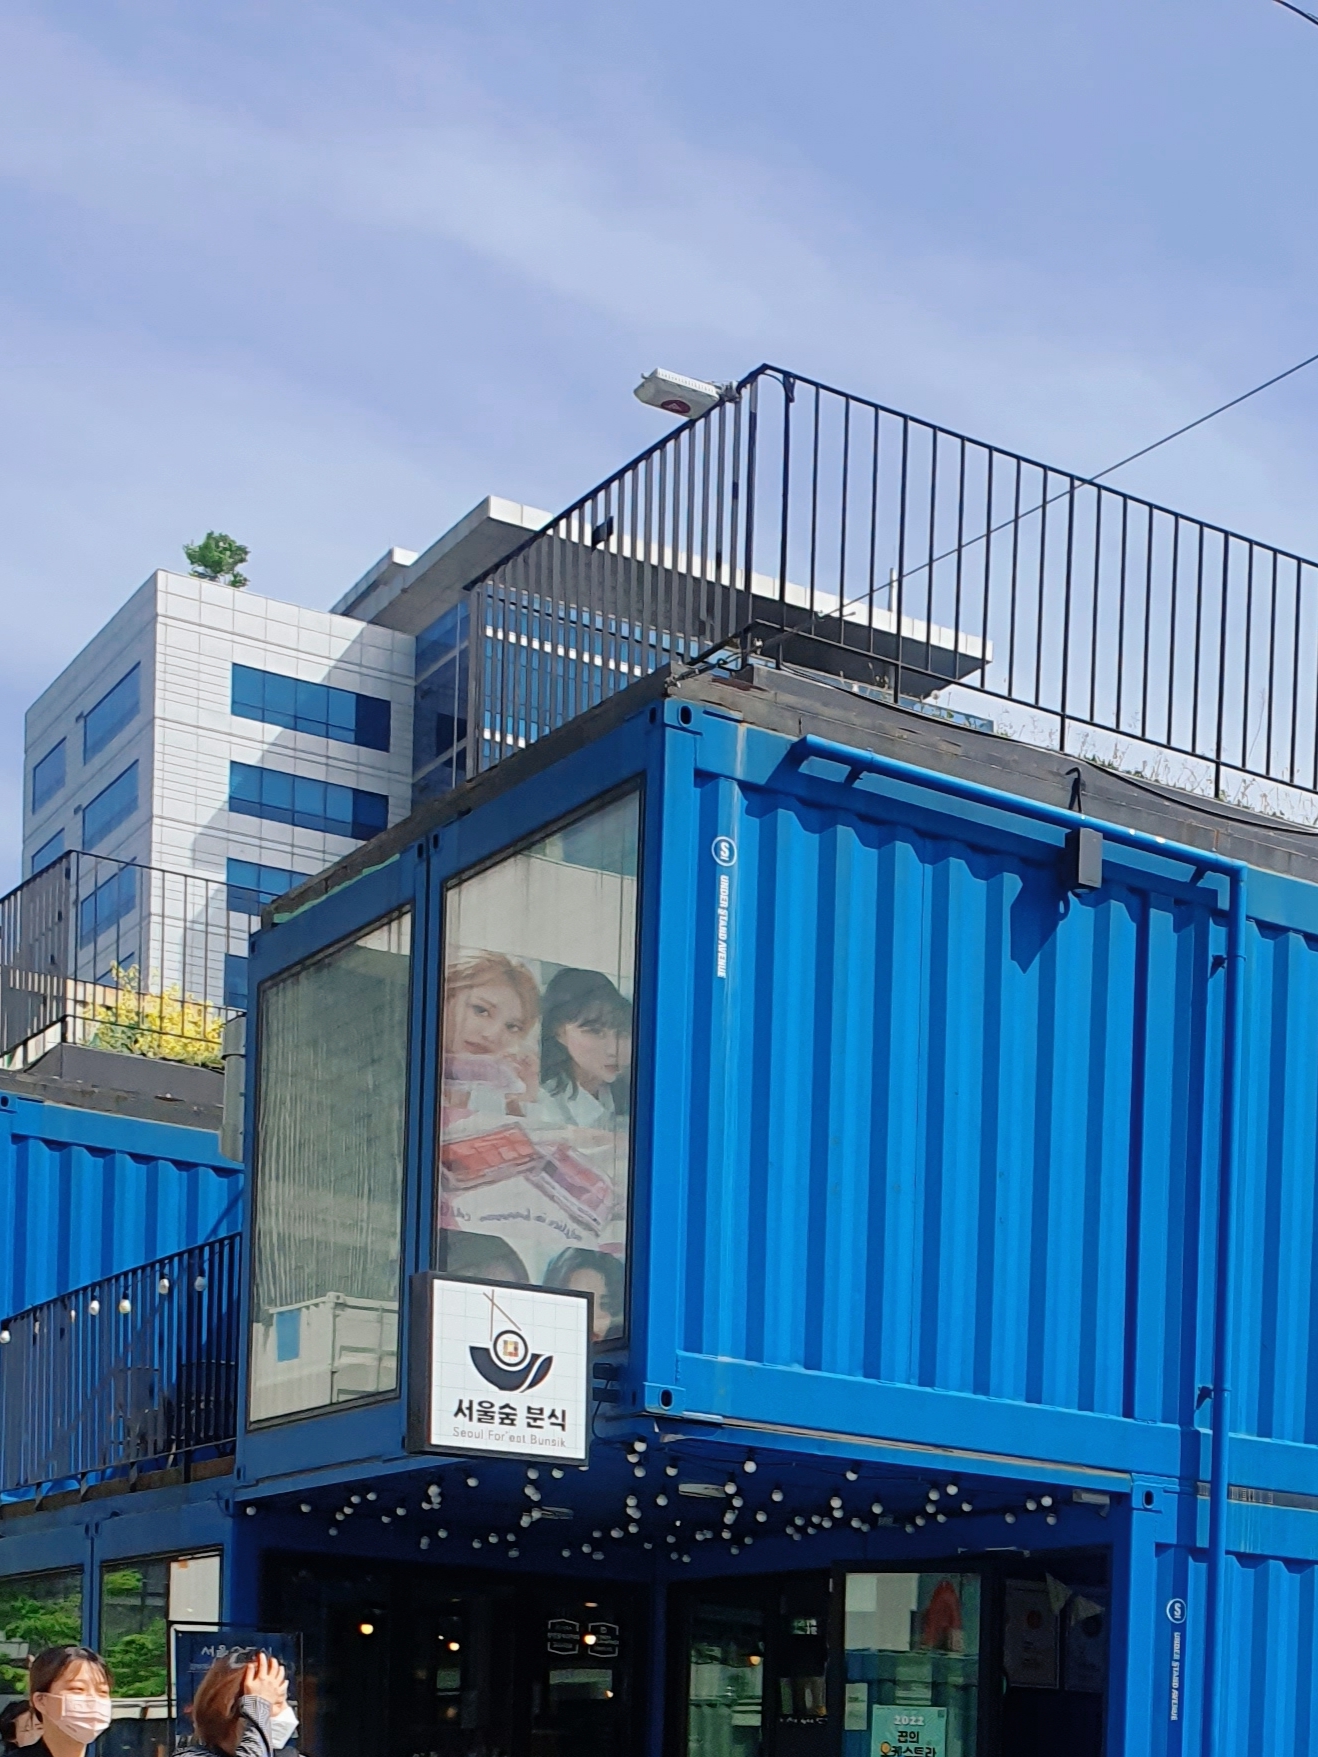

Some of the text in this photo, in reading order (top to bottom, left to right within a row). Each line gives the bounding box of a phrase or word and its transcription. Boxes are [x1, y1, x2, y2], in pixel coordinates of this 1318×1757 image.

[453, 1398, 567, 1432] 서울숲 분식
[452, 1426, 484, 1439] Seoul
[530, 1433, 567, 1448] Bunsik
[893, 1715, 925, 1726] 2022
